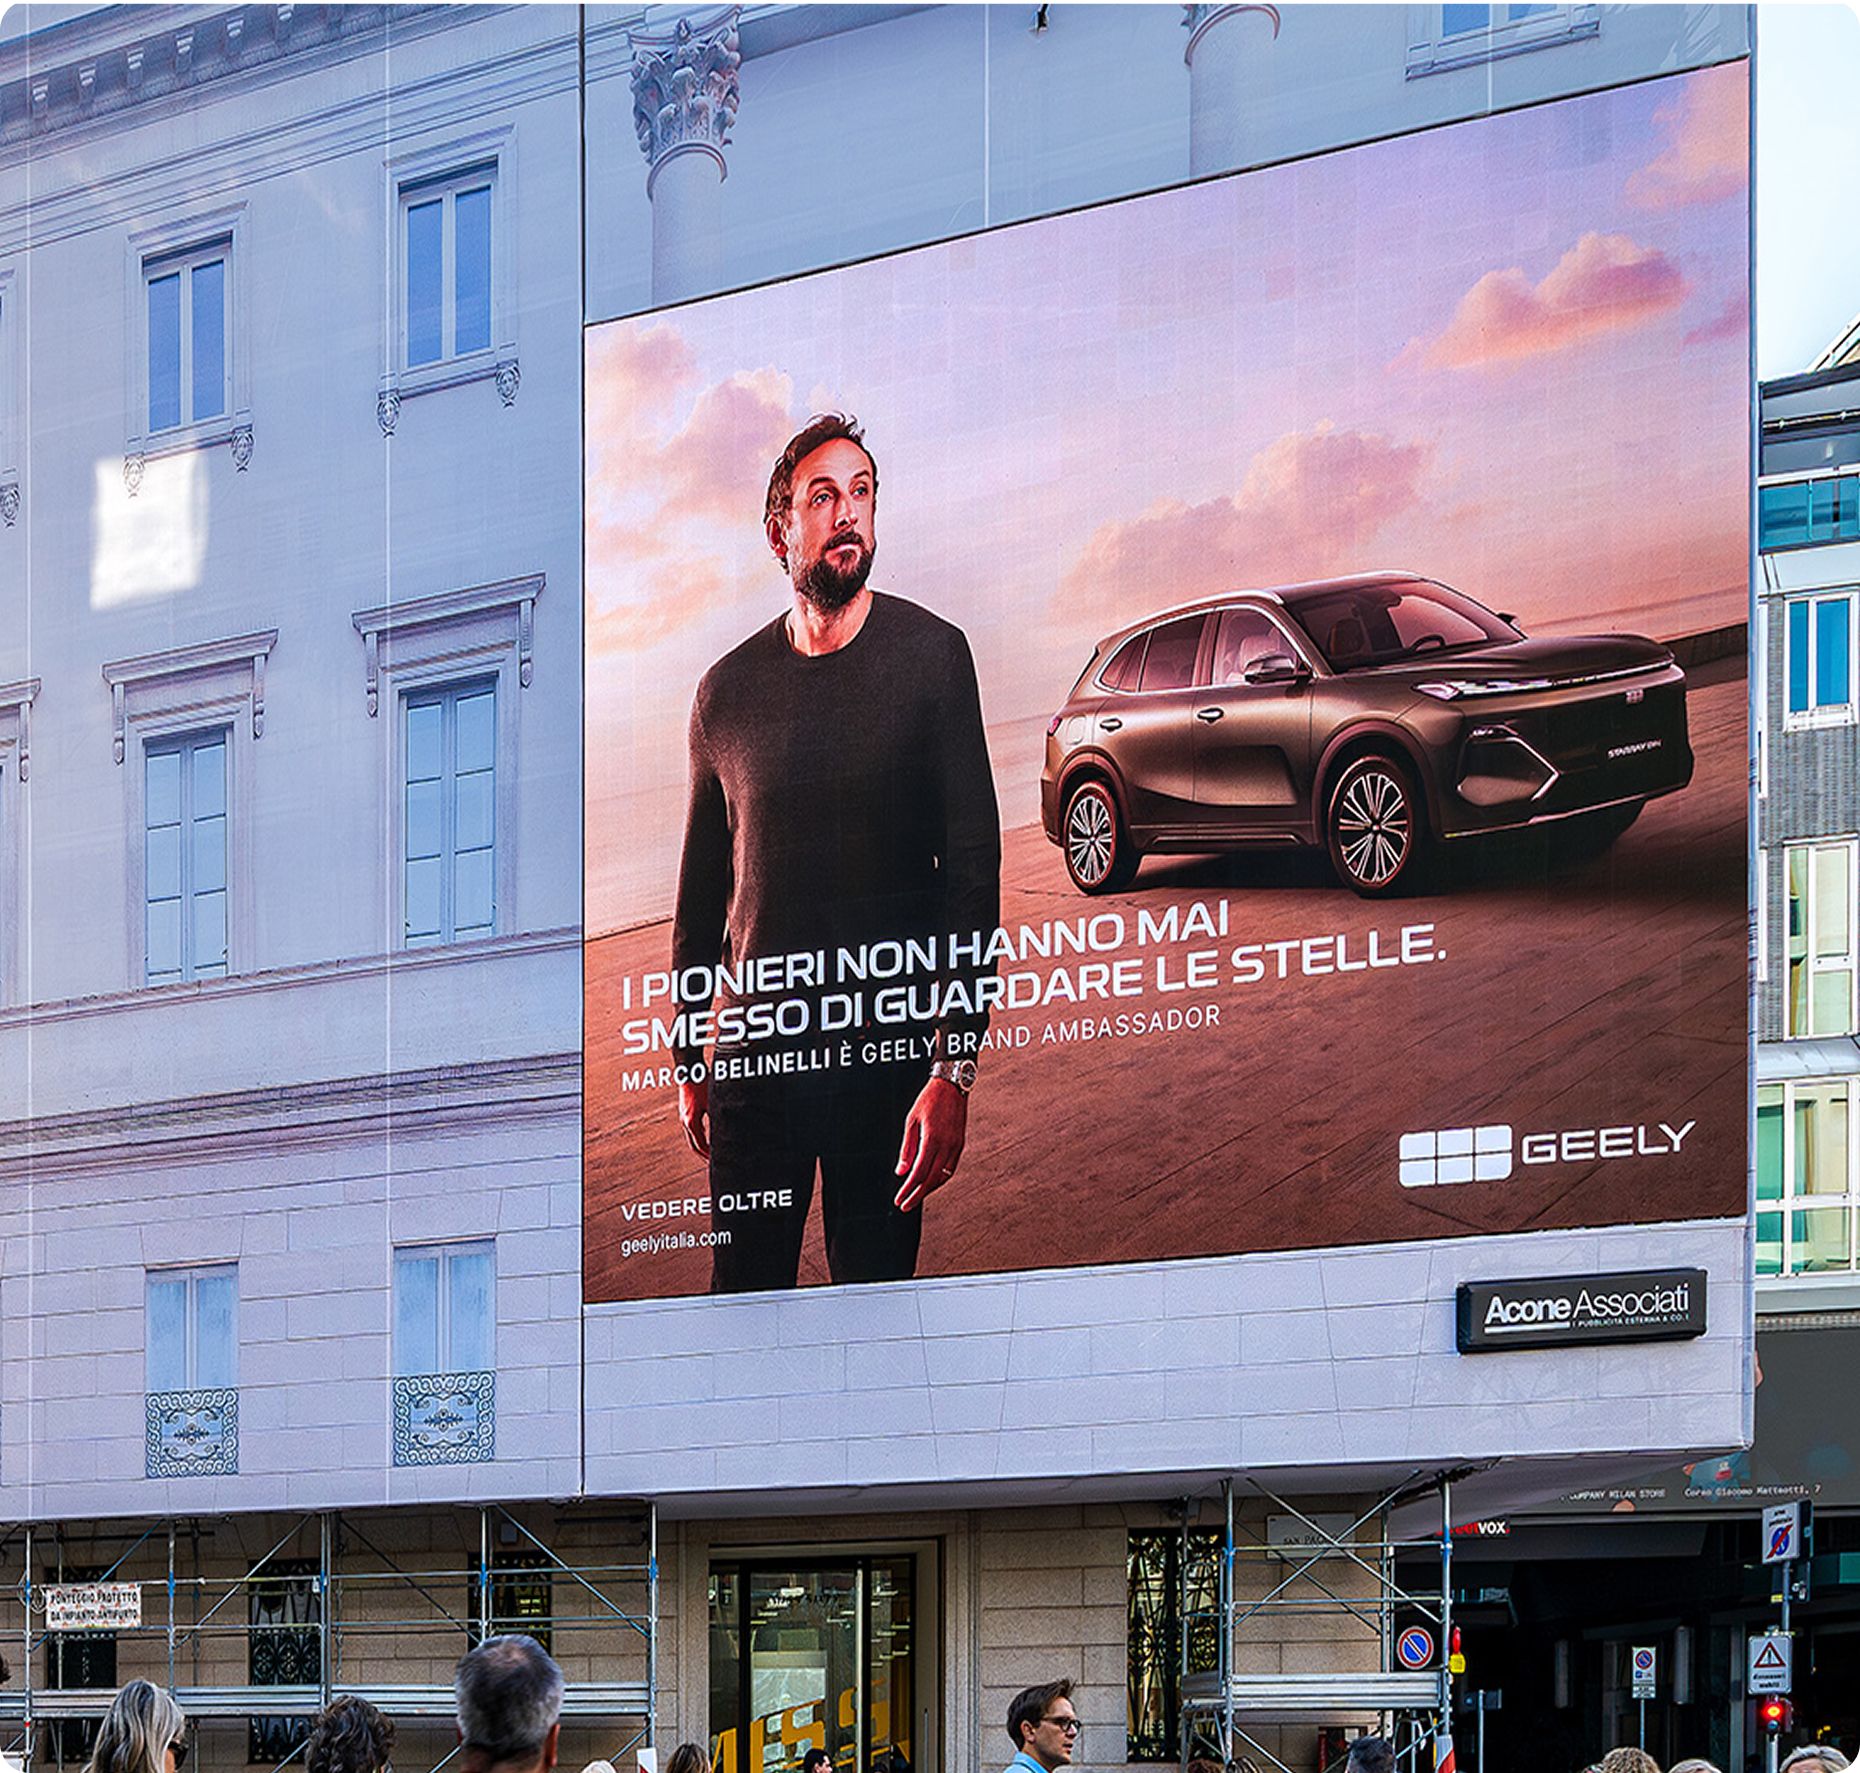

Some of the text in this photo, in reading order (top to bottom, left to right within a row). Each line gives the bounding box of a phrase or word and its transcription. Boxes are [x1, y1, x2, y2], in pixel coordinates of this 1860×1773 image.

[622, 899, 1229, 1011] I PIONIERI NON HANNO MAI
[622, 923, 1447, 1056] SMESSO DI GUARDARE LE STELLE.
[621, 1003, 1221, 1092] MARCO BELINELLI È GEELY BRAND AMBASSADOR
[1522, 1121, 1696, 1165] GEELY
[620, 1189, 793, 1222] VEDERE OLTRE
[620, 1231, 733, 1257] geelyitalia.com
[1484, 1282, 1690, 1326] Acone Associati
